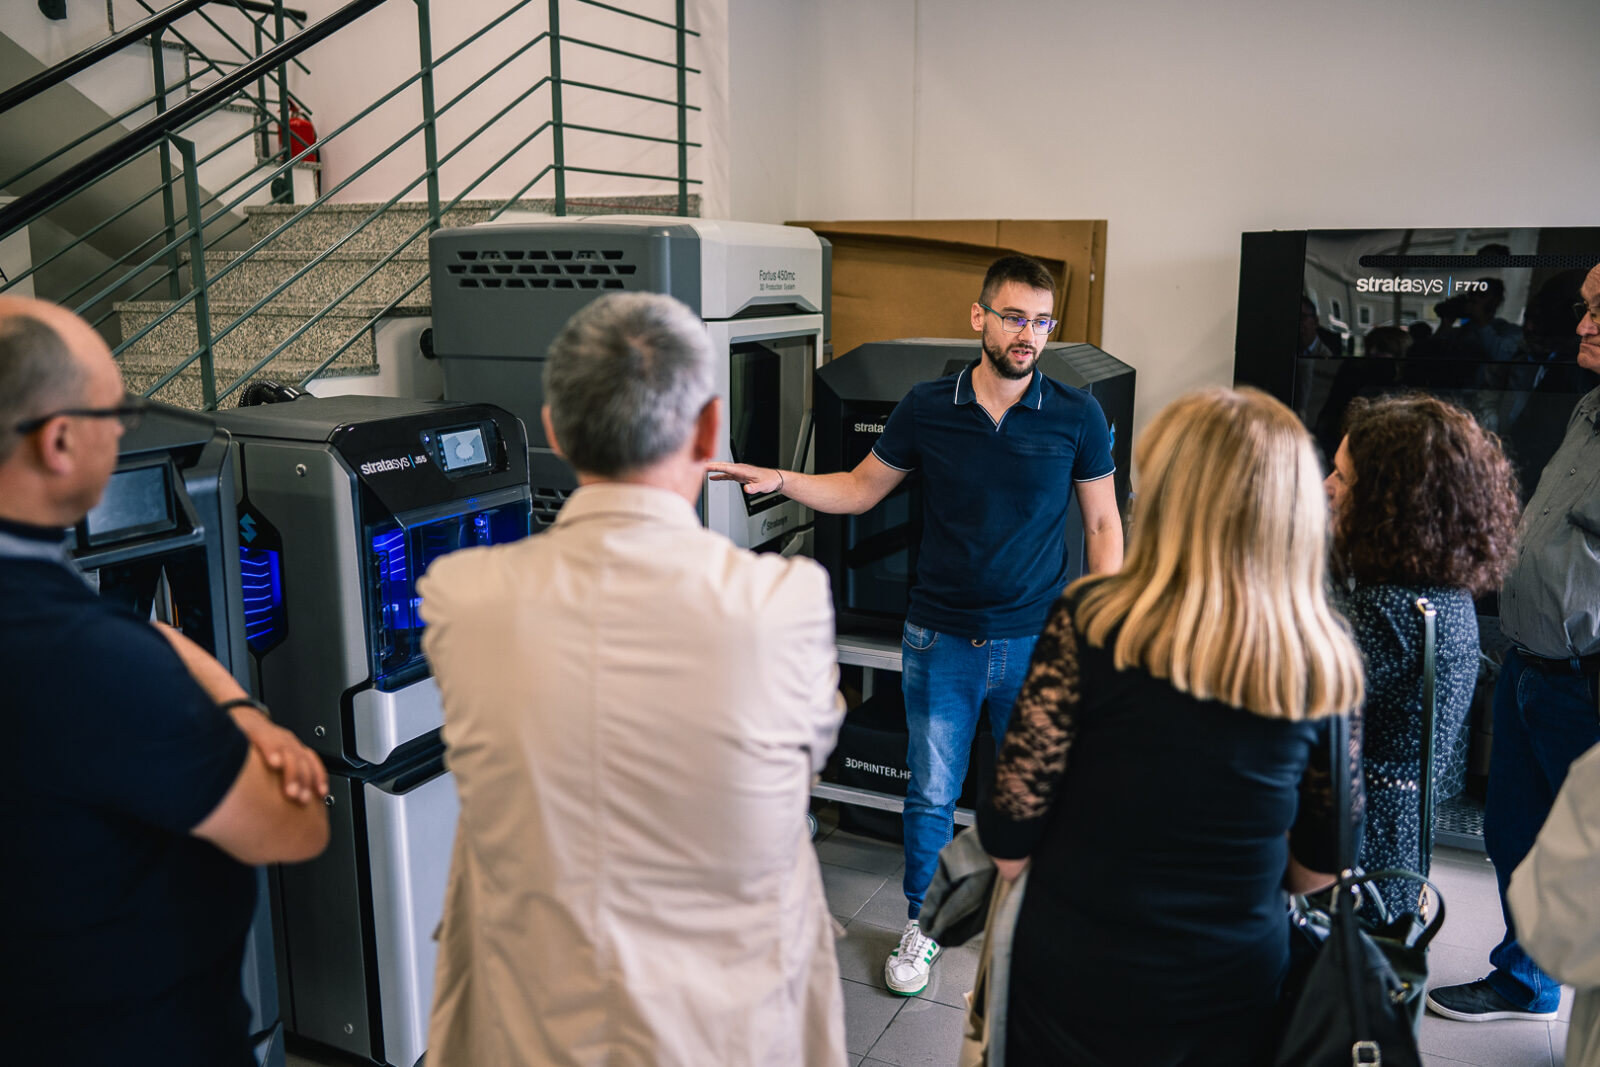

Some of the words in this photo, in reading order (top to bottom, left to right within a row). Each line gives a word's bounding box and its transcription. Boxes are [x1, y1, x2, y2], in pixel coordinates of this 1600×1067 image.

[759, 269, 777, 281] Fortus
[777, 269, 796, 281] 450mc
[1356, 276, 1443, 295] stratasys
[1455, 281, 1488, 292] F770
[360, 456, 411, 475] stratasys
